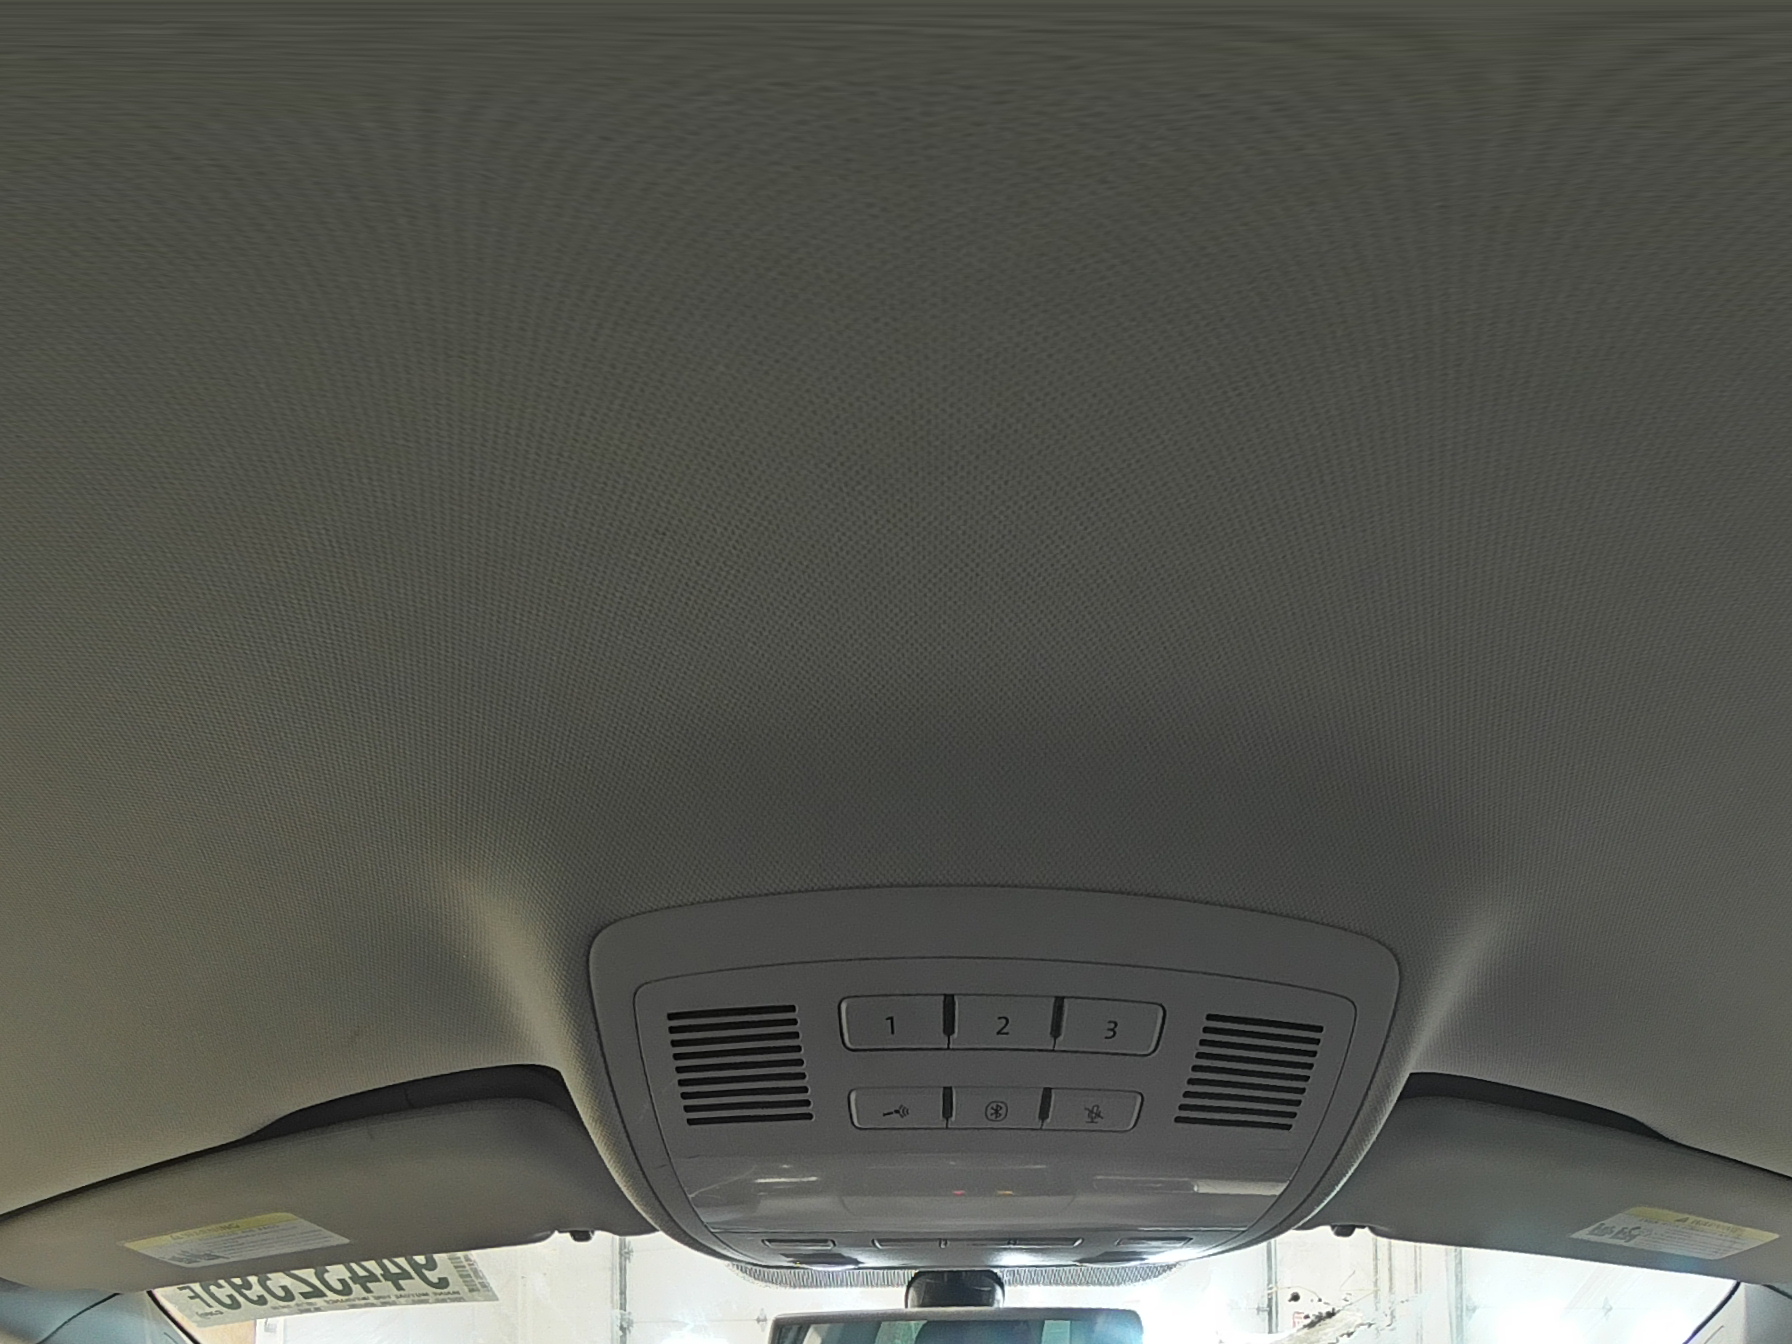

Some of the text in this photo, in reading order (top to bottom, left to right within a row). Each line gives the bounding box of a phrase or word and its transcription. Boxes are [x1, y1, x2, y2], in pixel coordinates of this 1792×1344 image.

[885, 1015, 897, 1036] 1
[995, 1015, 1010, 1036] 2
[1104, 1019, 1119, 1041] 3
